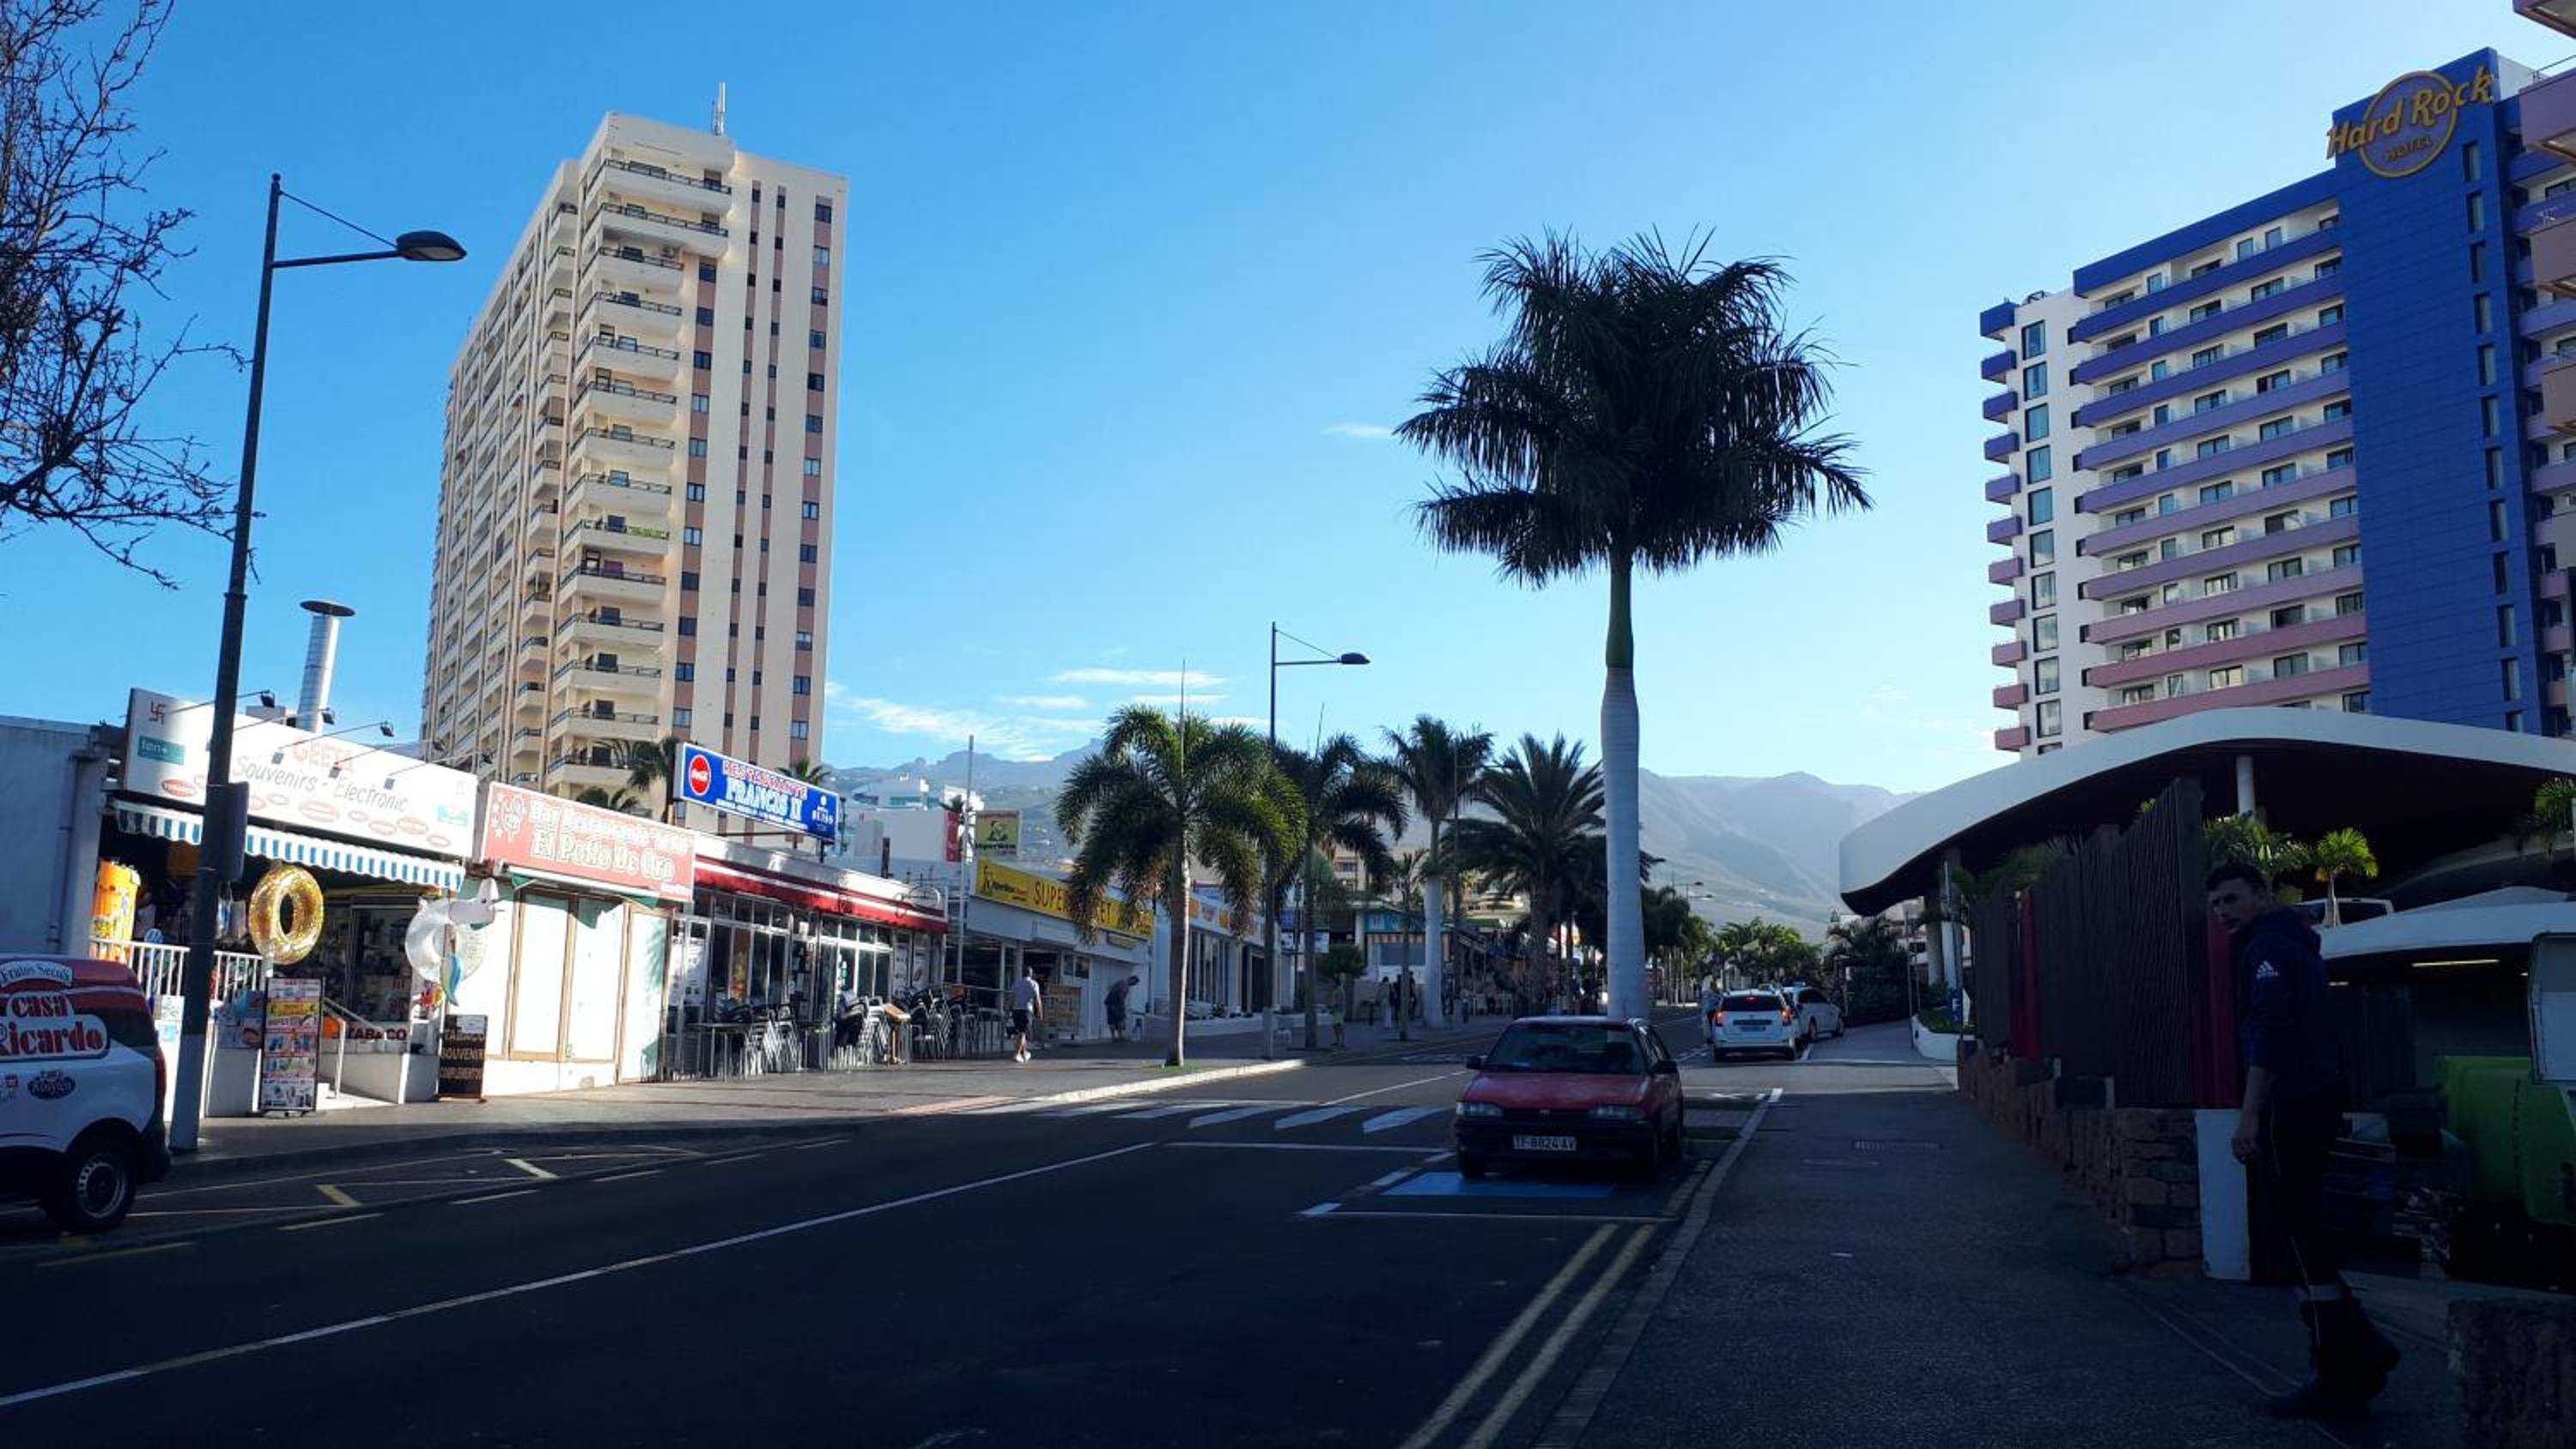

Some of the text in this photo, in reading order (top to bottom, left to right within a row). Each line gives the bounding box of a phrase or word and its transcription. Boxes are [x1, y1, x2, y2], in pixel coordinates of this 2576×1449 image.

[2326, 64, 2494, 159] Hard Rock
[233, 755, 319, 793] Souvenirs
[333, 776, 408, 813] Electronic
[726, 778, 788, 816] FRANCIS
[532, 828, 556, 860] El
[11, 994, 69, 1017] casa
